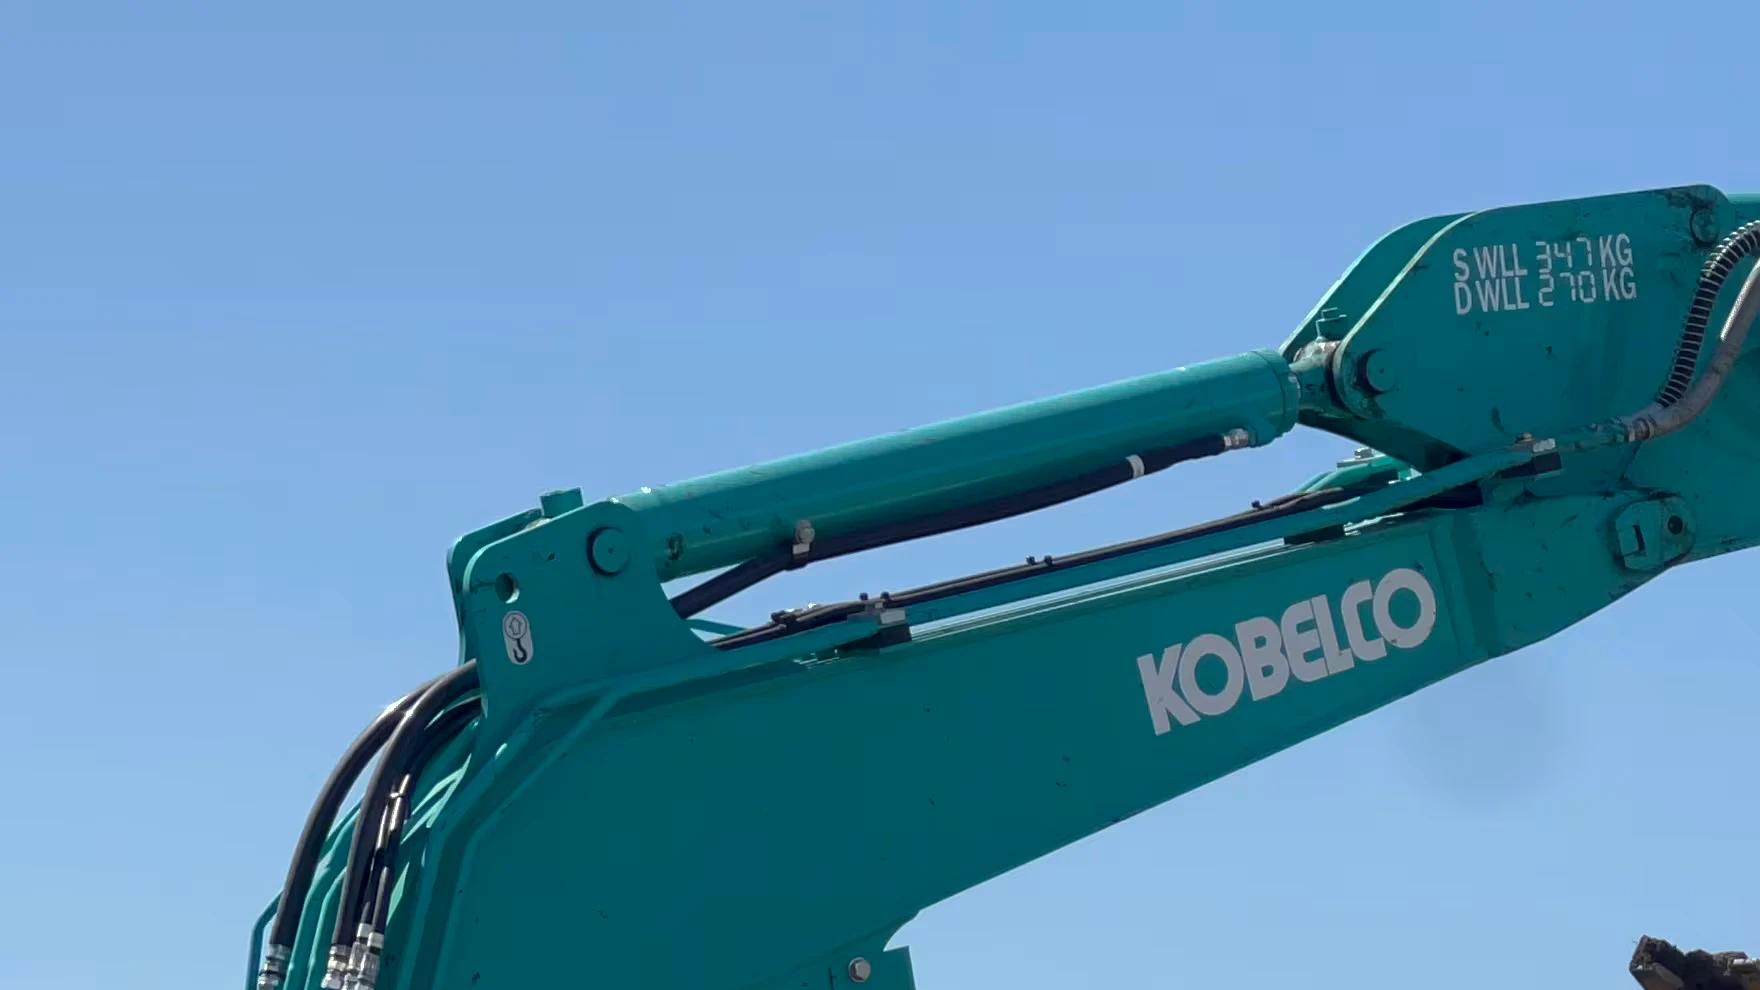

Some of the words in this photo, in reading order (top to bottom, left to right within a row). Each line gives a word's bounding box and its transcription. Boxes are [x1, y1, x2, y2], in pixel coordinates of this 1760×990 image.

[1536, 236, 1593, 272] 347
[1600, 233, 1633, 268] KG
[1538, 270, 1597, 306] 270
[1602, 267, 1637, 301] KG
[1136, 568, 1437, 736] KOBELCO
